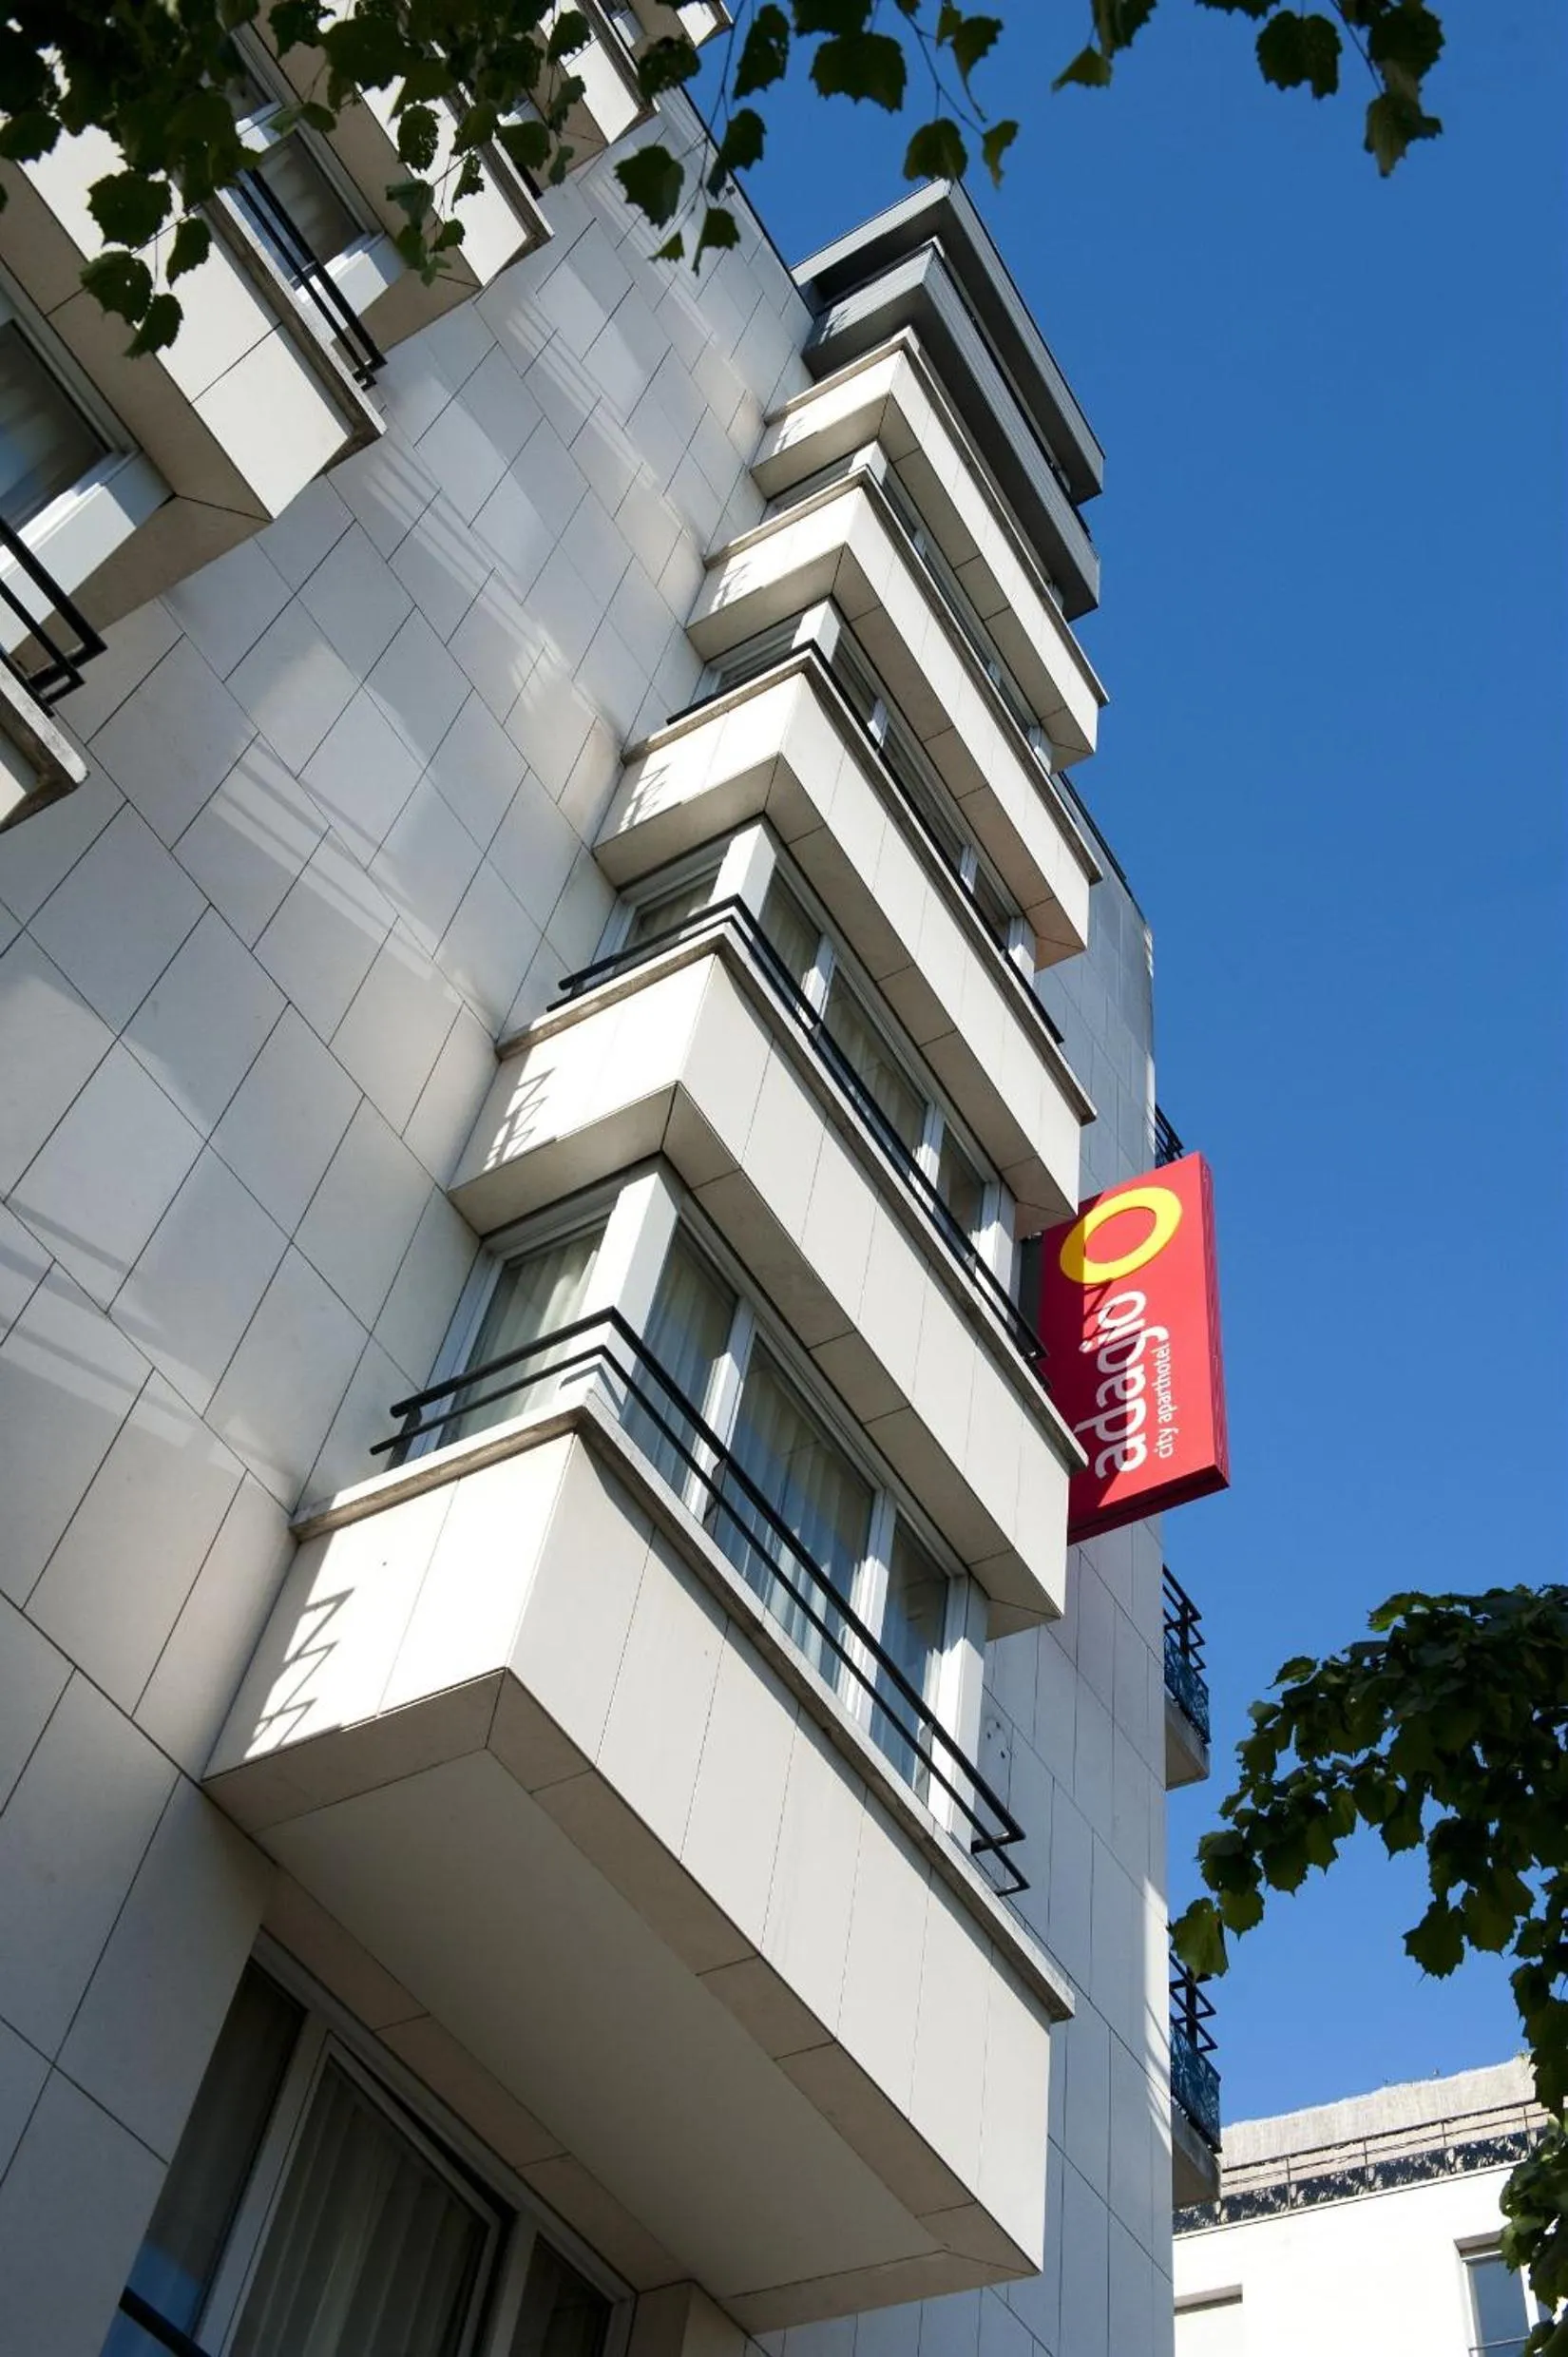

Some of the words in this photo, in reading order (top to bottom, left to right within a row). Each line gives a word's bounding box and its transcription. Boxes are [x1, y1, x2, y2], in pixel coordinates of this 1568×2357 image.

[1075, 1291, 1169, 1478] adagio
[1151, 1343, 1177, 1424] aparthotel
[1153, 1428, 1178, 1458] city
